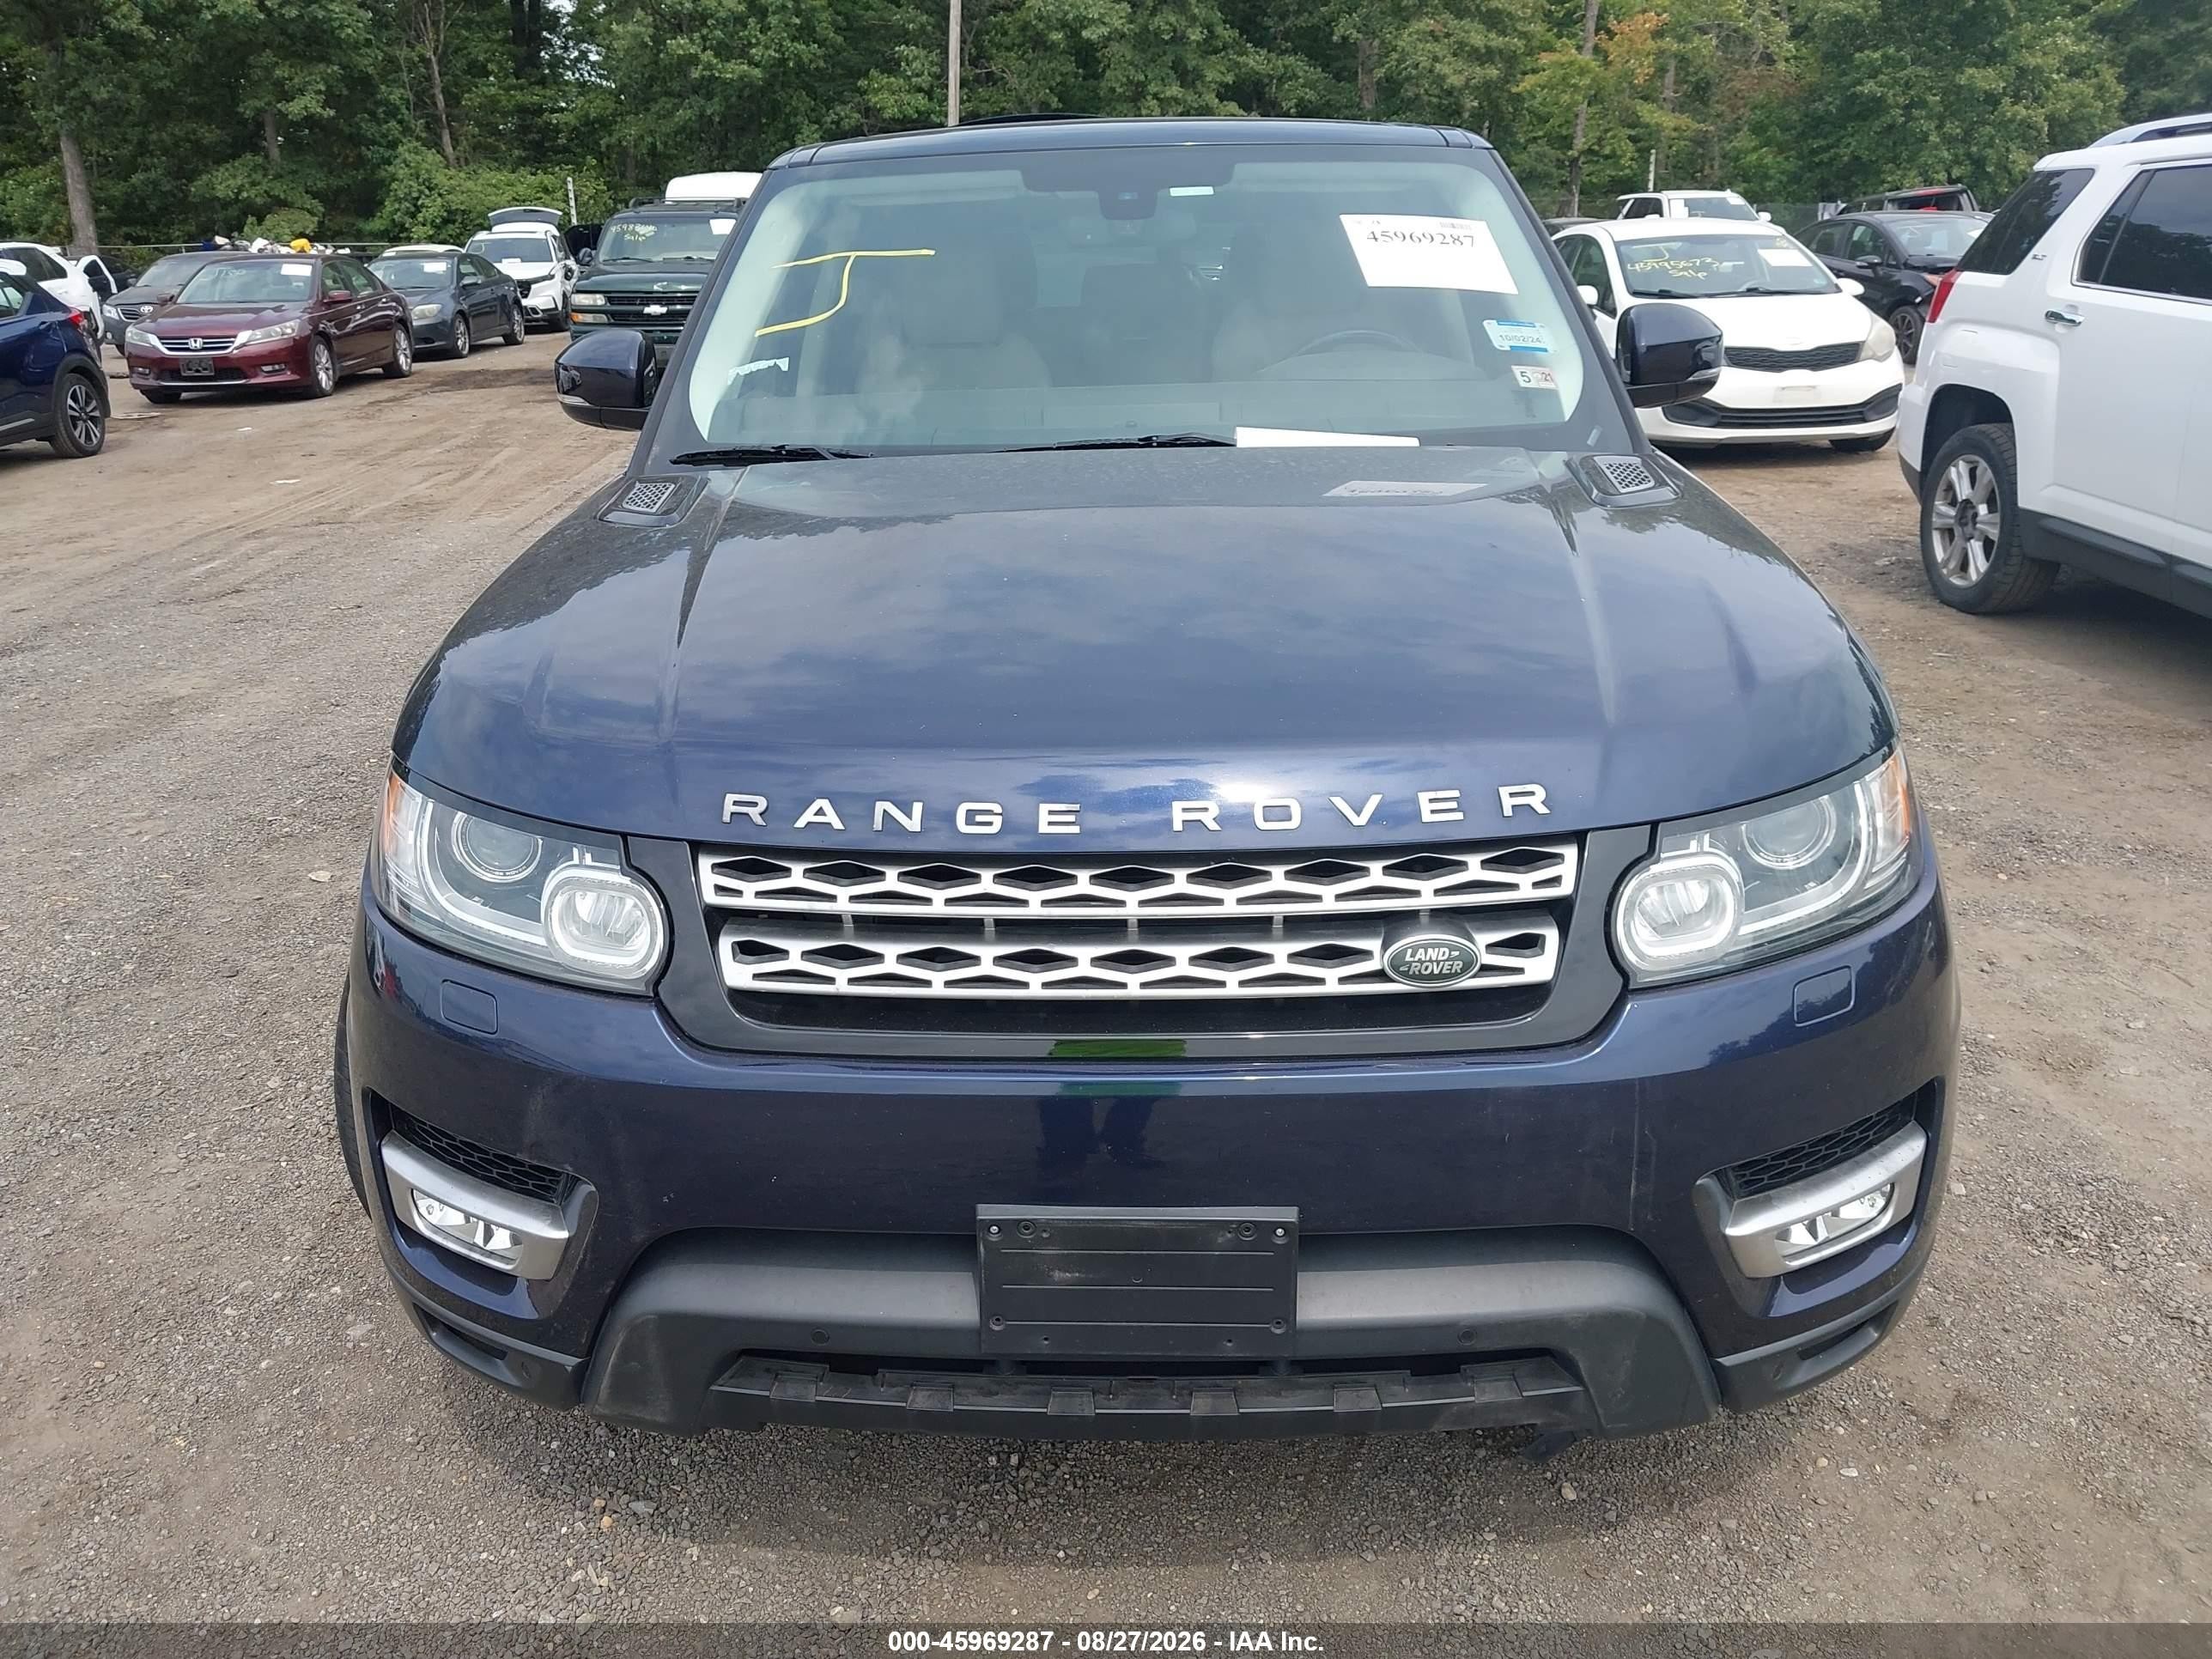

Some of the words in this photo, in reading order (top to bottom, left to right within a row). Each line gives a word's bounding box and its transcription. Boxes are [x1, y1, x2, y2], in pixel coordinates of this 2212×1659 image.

[1367, 229, 1474, 247] 45969287
[1519, 371, 1532, 383] 5
[721, 793, 1082, 835] RANGE
[1171, 783, 1552, 832] ROVER
[1404, 947, 1450, 962] LAND
[1408, 960, 1464, 975] ROVER
